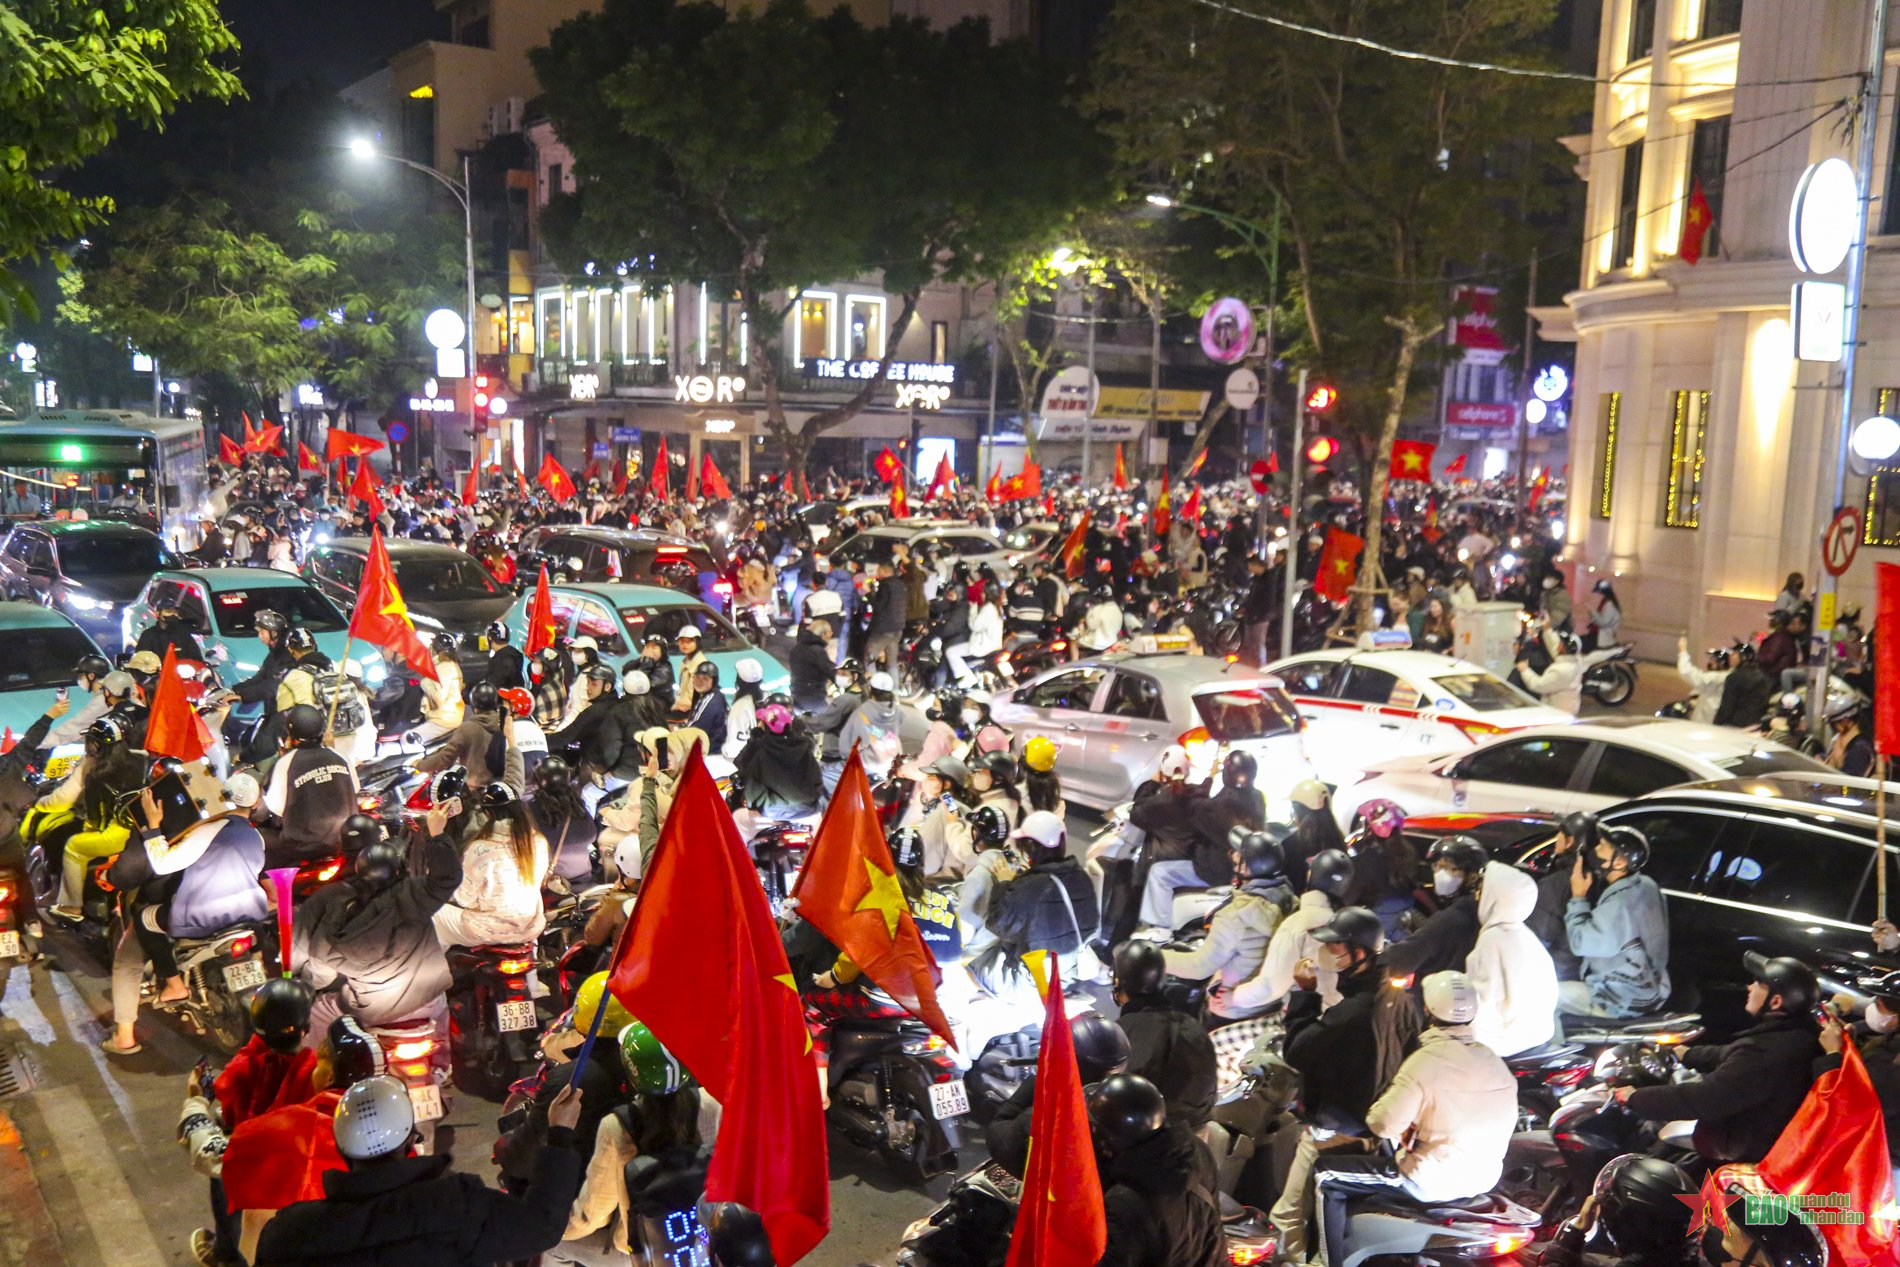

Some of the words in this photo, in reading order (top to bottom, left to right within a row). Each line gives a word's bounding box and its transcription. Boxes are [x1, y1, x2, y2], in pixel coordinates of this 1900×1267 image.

[816, 359, 846, 378] THE
[848, 361, 906, 381] COFEE
[907, 363, 956, 383] HOUSE
[500, 1014, 535, 1030] 327.38
